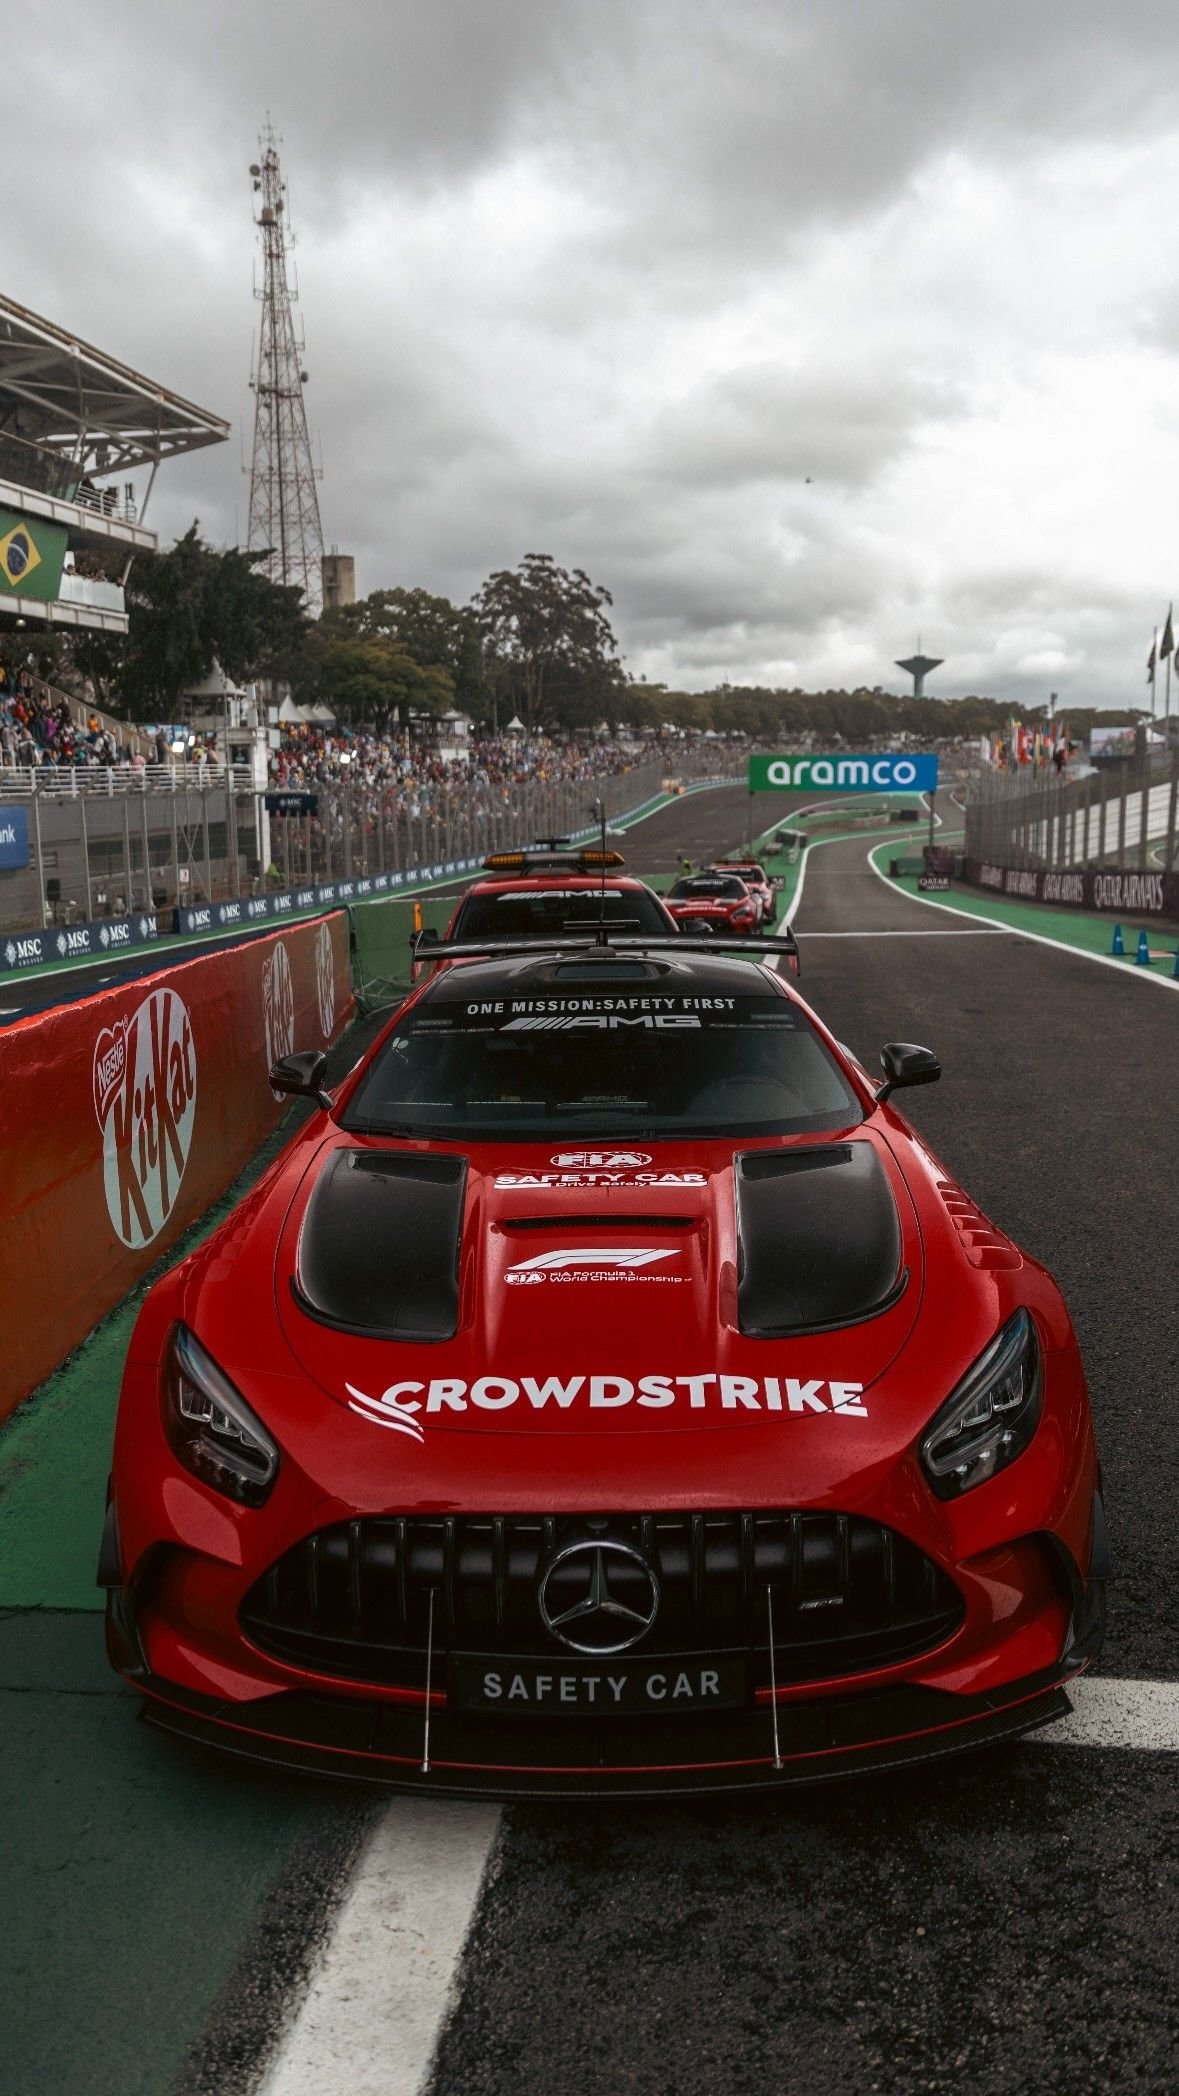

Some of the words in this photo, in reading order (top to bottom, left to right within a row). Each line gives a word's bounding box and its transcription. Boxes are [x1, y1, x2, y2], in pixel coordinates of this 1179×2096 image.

[767, 761, 916, 785] aramco
[920, 878, 949, 886] QATAR
[1094, 875, 1121, 908] QATAR
[1123, 875, 1163, 910] AIRWAYS
[226, 903, 240, 919] MSC
[254, 899, 267, 914] MSC
[195, 909, 211, 926] MSC
[67, 930, 90, 949] MSC
[109, 924, 130, 941] MSC
[16, 938, 42, 958] MSC
[467, 1003, 504, 1015] ONE
[682, 999, 735, 1009] FIRST
[561, 1015, 702, 1030] AMG
[113, 992, 194, 1244] KitKat
[558, 1154, 642, 1166] FIA
[496, 1174, 625, 1185] SAFETY
[634, 1174, 706, 1183] CAR
[380, 1374, 868, 1417] CROWDSTRIKE
[484, 1673, 627, 1702] SAFETY
[646, 1671, 720, 1701] CAR
